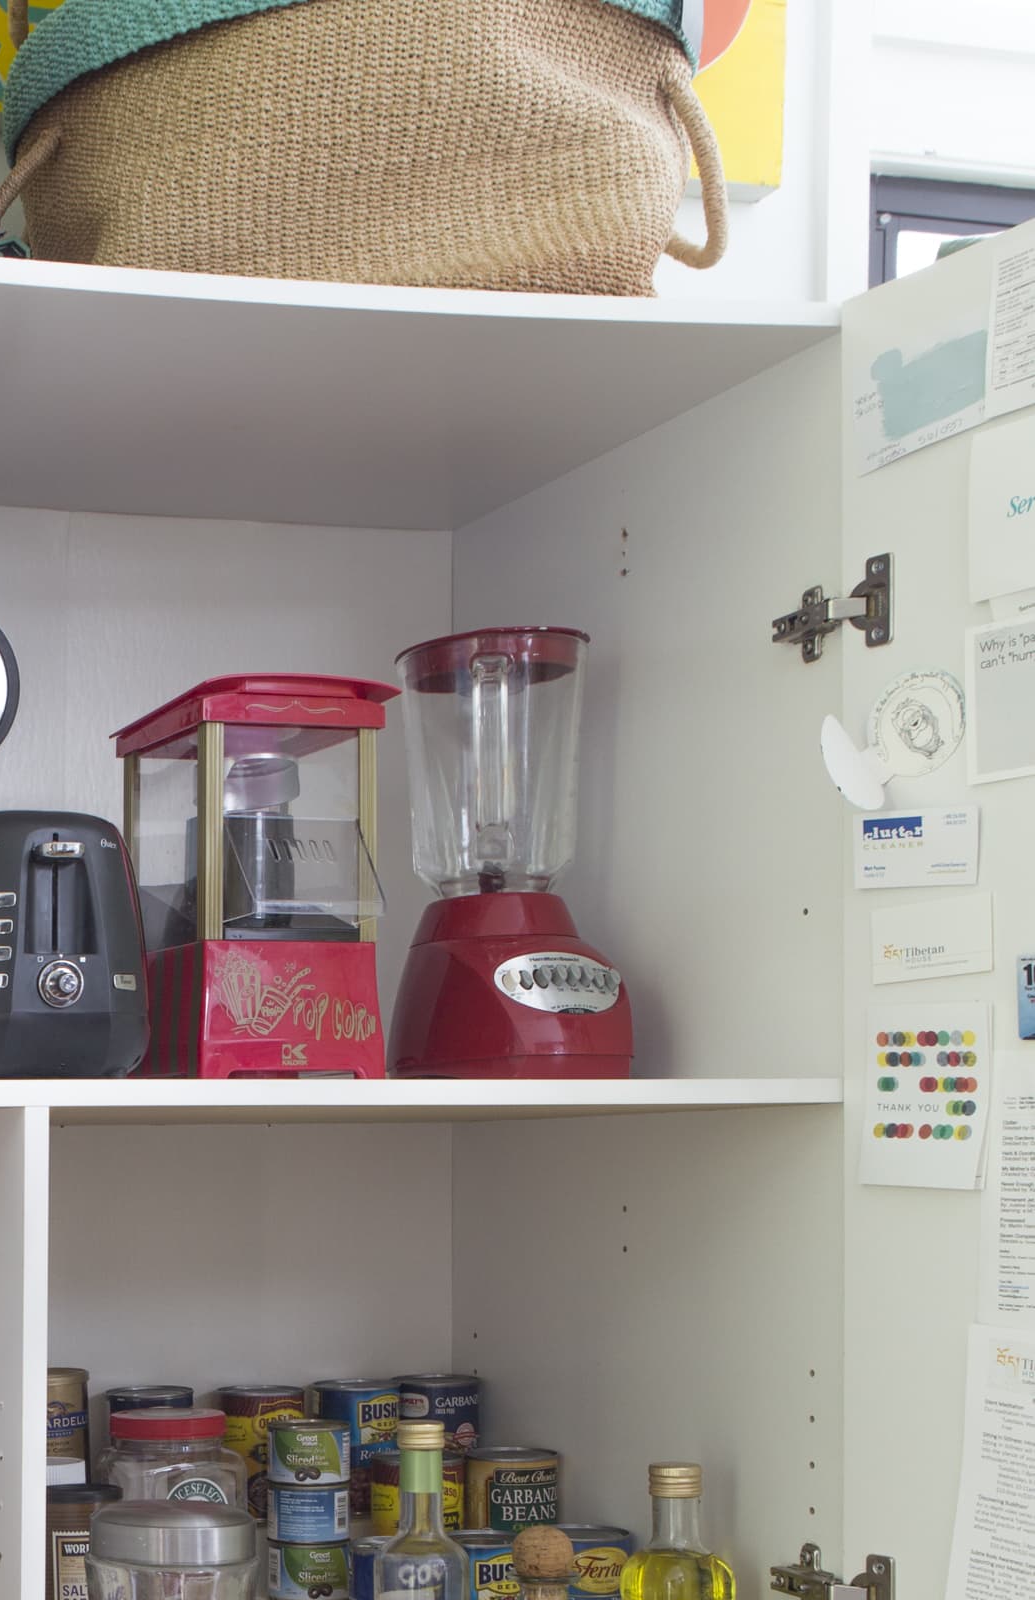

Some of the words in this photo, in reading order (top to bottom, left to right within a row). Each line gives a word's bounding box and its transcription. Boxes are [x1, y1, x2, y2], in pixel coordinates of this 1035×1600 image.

[980, 639, 1005, 654] Why
[1008, 637, 1017, 648] is
[980, 653, 1005, 670] can't
[864, 824, 923, 841] clutter
[863, 841, 925, 850] CLEANER
[904, 944, 944, 958] Tibetan
[293, 993, 329, 1040] POP
[876, 1103, 912, 1112] THANK
[917, 1103, 940, 1112] YOU
[296, 1433, 318, 1443] Great
[286, 1454, 315, 1465] Sliced
[500, 1471, 529, 1485] Best
[491, 1486, 557, 1503] GARBANZ
[502, 1505, 557, 1521] BEANS
[298, 1572, 327, 1583] Sliced
